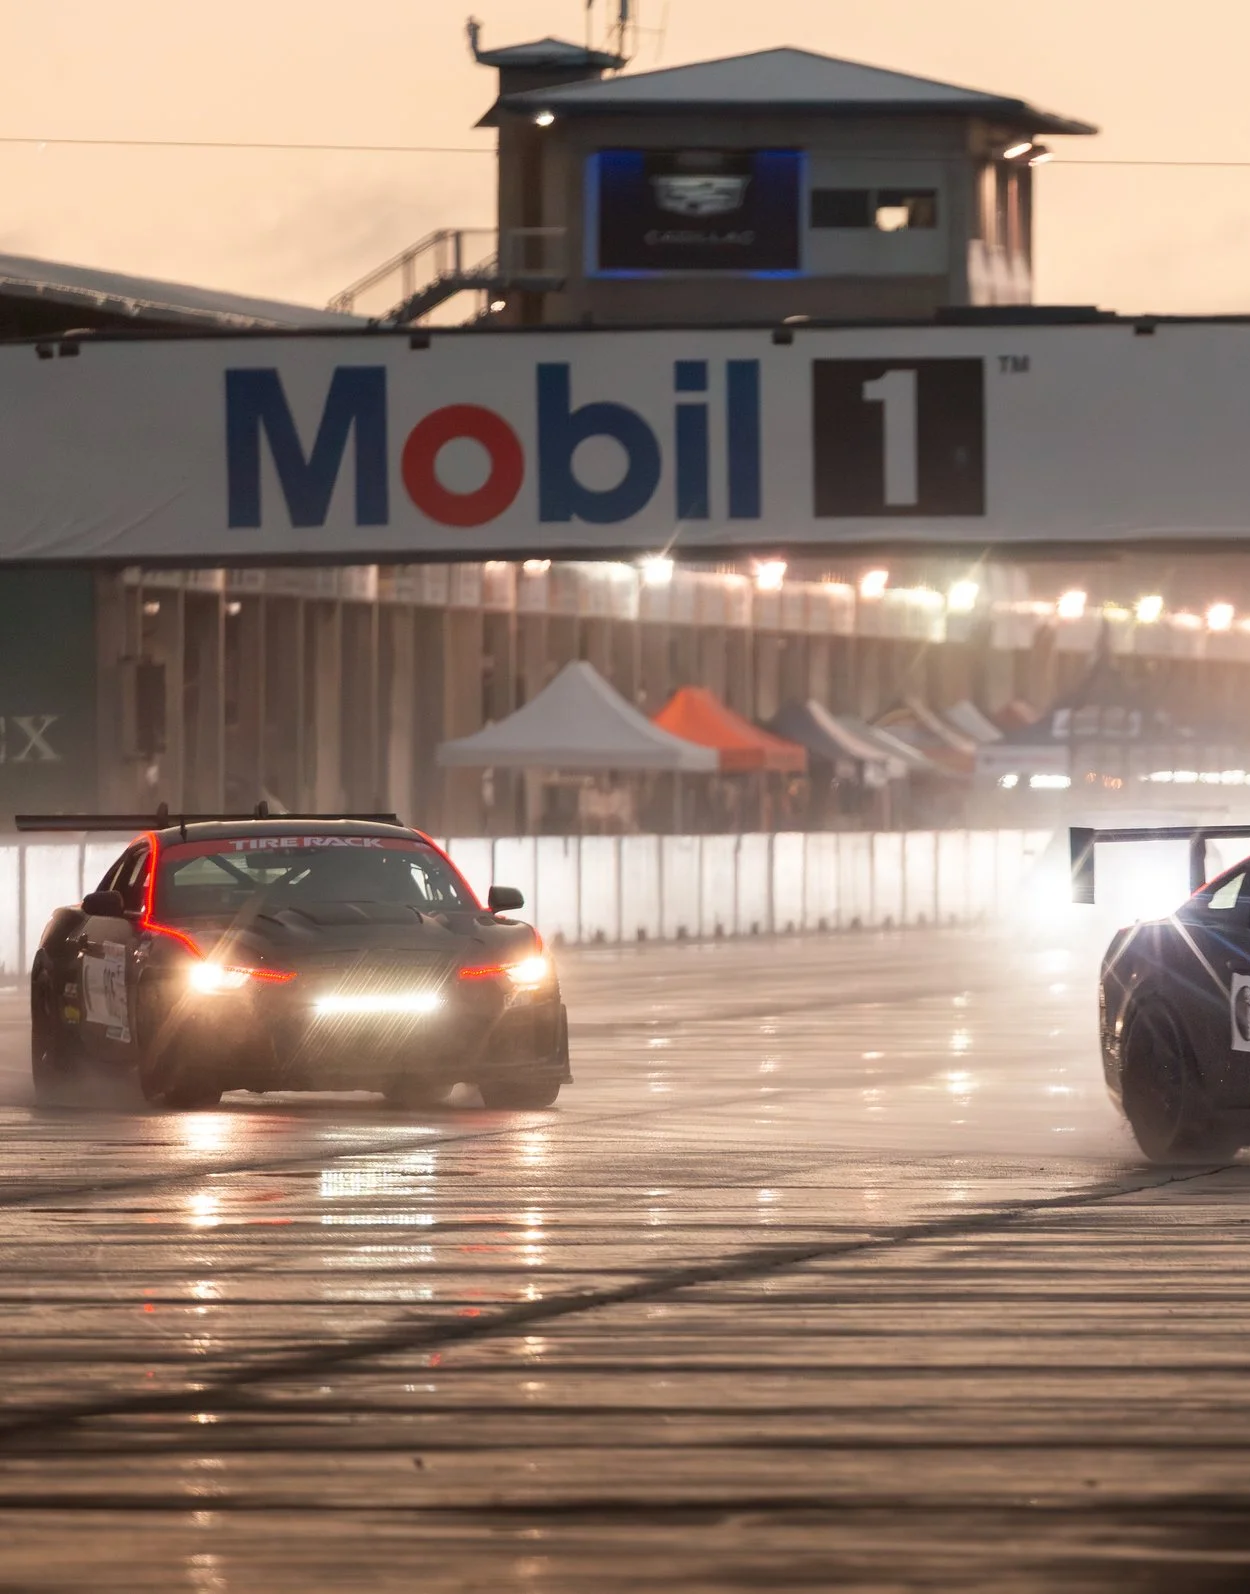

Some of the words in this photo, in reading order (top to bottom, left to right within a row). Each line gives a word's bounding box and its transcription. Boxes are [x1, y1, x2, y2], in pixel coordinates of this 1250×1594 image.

[224, 358, 763, 528] Mobil
[862, 369, 917, 506] 1
[0, 716, 60, 763] X
[230, 837, 299, 850] TIRE
[304, 836, 383, 848] RACK
